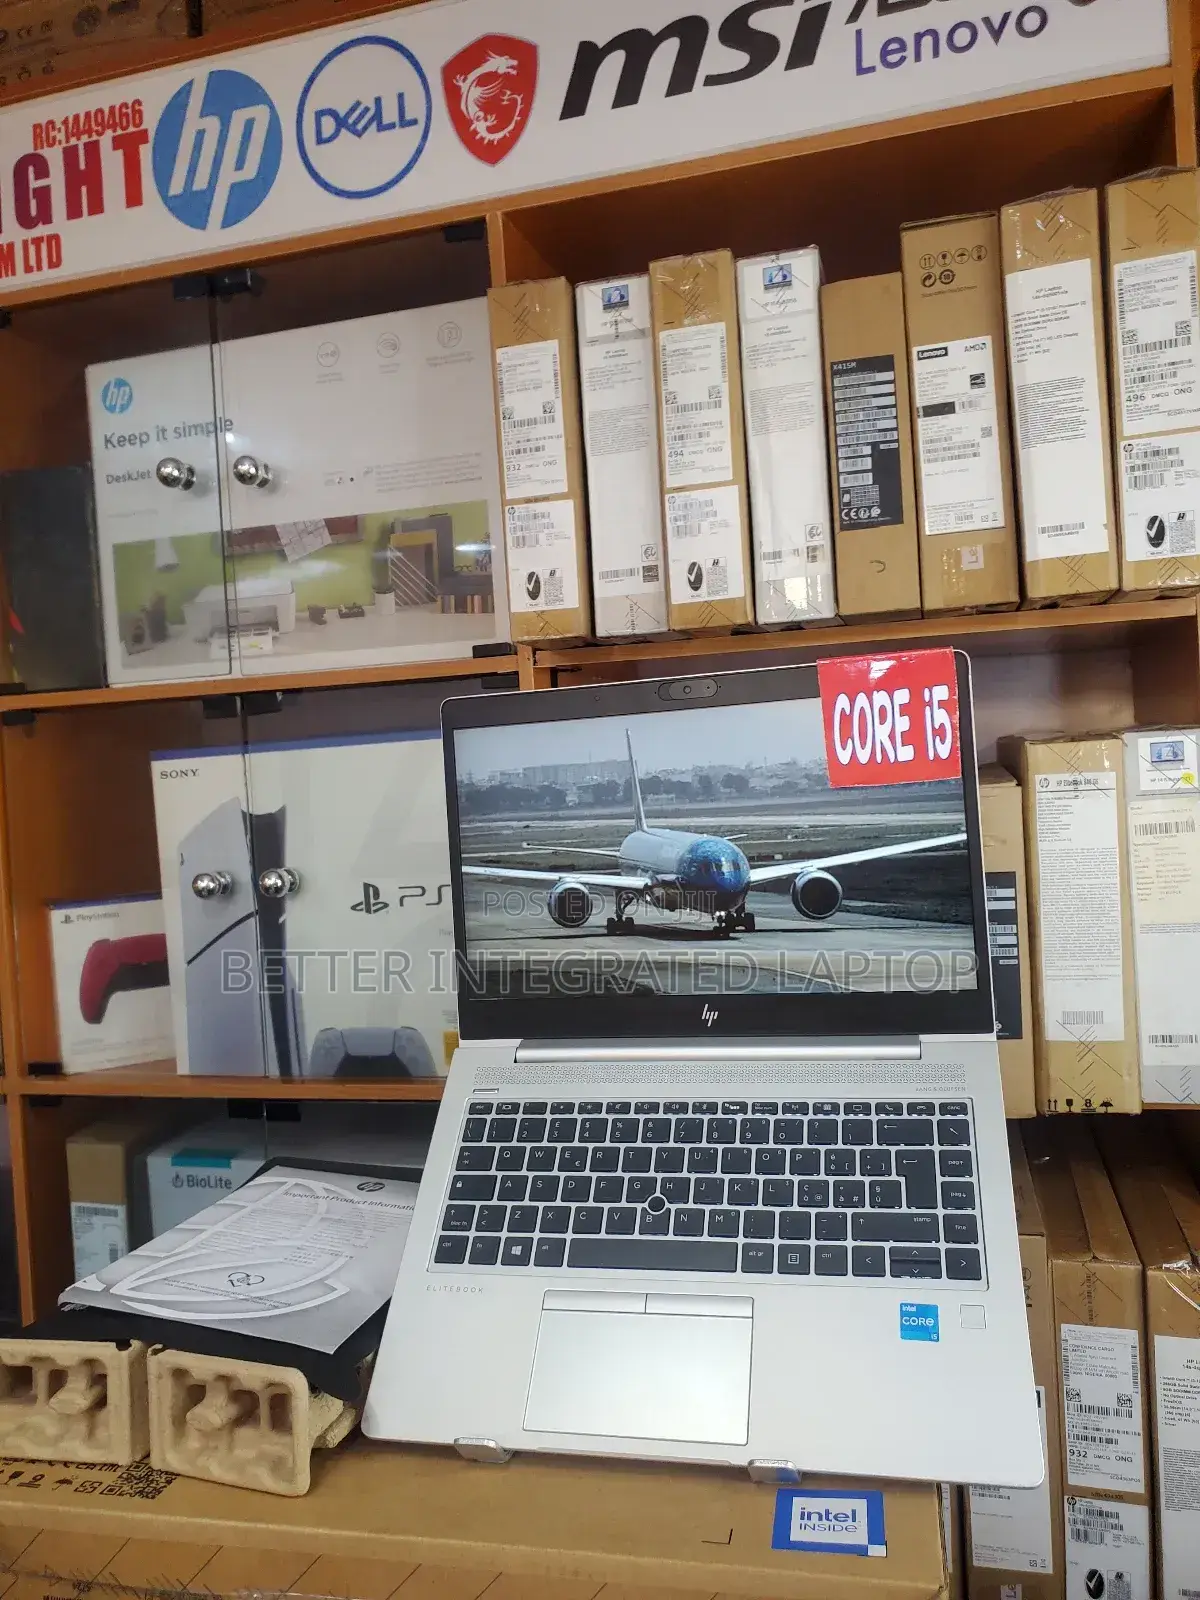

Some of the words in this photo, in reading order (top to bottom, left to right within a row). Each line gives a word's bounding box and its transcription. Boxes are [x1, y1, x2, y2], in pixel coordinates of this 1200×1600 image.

[855, 5, 1049, 76] Lenovo
[32, 98, 144, 151] RC:1449466
[314, 92, 418, 146] DELL
[166, 69, 272, 230] hp
[0, 128, 149, 234] GHT
[22, 232, 63, 274] LTD
[1126, 392, 1146, 403] 496
[1173, 386, 1193, 396] ONG
[104, 430, 150, 450] Keep
[156, 424, 168, 441] it
[174, 417, 234, 439] simple
[668, 450, 684, 458] 494
[106, 469, 151, 485] DeskJet
[832, 687, 914, 767] CORE
[923, 684, 953, 761] i5
[160, 769, 199, 780] SONY
[76, 911, 120, 923] PlayStation
[187, 1175, 232, 1190] BioLite
[281, 1190, 330, 1201] Important
[330, 1195, 367, 1206] Product
[426, 1285, 484, 1293] ELITEBOOK
[1068, 1449, 1088, 1459] 932
[1114, 1455, 1133, 1463] ONG
[800, 1507, 857, 1523] intel
